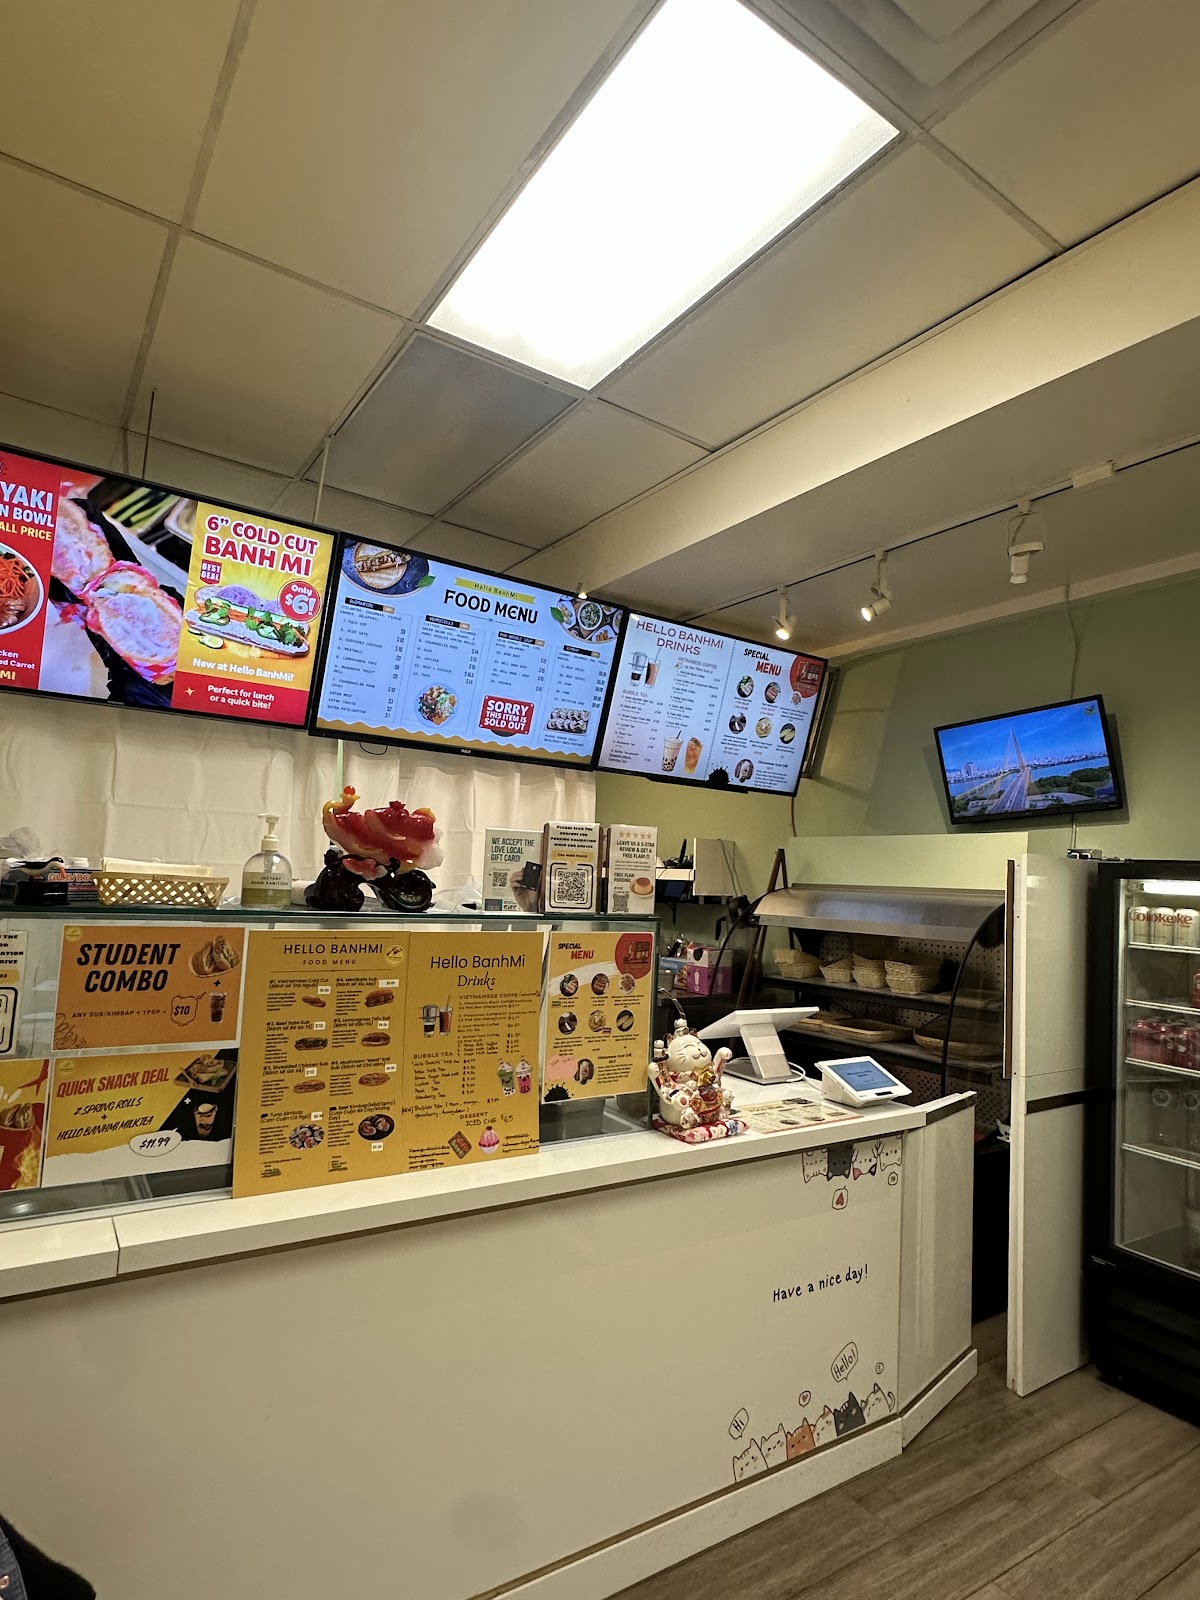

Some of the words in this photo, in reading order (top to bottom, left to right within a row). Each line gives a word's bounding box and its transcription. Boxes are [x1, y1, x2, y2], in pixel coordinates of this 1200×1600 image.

[13, 507, 54, 527] BOWL
[20, 526, 52, 540] PRICE
[232, 522, 280, 545] COLD
[284, 535, 318, 554] CUT
[205, 535, 276, 568] BANH
[280, 553, 311, 576] MI
[202, 563, 220, 573] BEST
[201, 571, 219, 581] DEAL
[291, 584, 313, 597] Only
[474, 583, 492, 593] Hello
[494, 588, 518, 598] BanhMi
[285, 593, 317, 616] $6!
[444, 589, 491, 613] FOOD
[494, 601, 538, 624] MENU
[636, 620, 676, 638] HELLO
[679, 631, 724, 649] BANHMI
[656, 637, 701, 656] DRINKS
[744, 648, 769, 661] SPECIAL
[10, 660, 35, 669] Carrot
[193, 658, 216, 669] New
[217, 662, 228, 671] at
[229, 664, 255, 676] Hello
[256, 668, 294, 682] BanhMi!
[756, 661, 782, 676] MENU
[208, 684, 239, 696] Perfect
[240, 689, 251, 698] for
[253, 691, 275, 701] lunch
[227, 698, 250, 708] quick
[252, 700, 271, 710] bite!
[487, 700, 529, 716] SORRY
[486, 711, 501, 719] THIS
[503, 714, 519, 722] ITEM
[484, 718, 506, 728] SOLD
[508, 721, 526, 731] OUT
[491, 837, 501, 845] WE
[501, 838, 522, 846] ACCEPT
[524, 838, 535, 847] THE
[491, 845, 505, 854] LOVE
[506, 846, 524, 855] LOCAL
[491, 853, 503, 862] GIFT
[504, 854, 521, 863] CARD!
[283, 944, 326, 955] HELLO
[331, 943, 383, 954] BANHMI
[557, 942, 582, 950] SPECIAL
[77, 943, 181, 967] STUDENT
[430, 955, 468, 969] Hello
[472, 954, 526, 968] BanhMi
[570, 950, 596, 960] MENU
[84, 969, 169, 993] COMBO
[457, 971, 496, 991] Drinks
[89, 1010, 135, 1018] SUB/KIMBAP
[173, 1005, 191, 1016] $10
[413, 1052, 439, 1060] BUBBLE
[56, 1080, 95, 1098] QUICK
[97, 1073, 139, 1095] SNACK
[141, 1067, 170, 1085] DEAL
[81, 1101, 115, 1116] SPRING
[116, 1096, 144, 1111] ROLLS
[459, 1112, 488, 1120] DESSERT
[56, 1128, 82, 1141] HELLO
[83, 1122, 119, 1138] BANHMI
[119, 1115, 154, 1131] MILKTEA
[139, 1136, 171, 1149] $11.99
[772, 1284, 803, 1302] Have
[807, 1280, 815, 1293] a
[818, 1272, 842, 1290] nice
[844, 1263, 869, 1286] day!
[834, 1348, 855, 1379] Hello!
[731, 1417, 746, 1432] Hi
